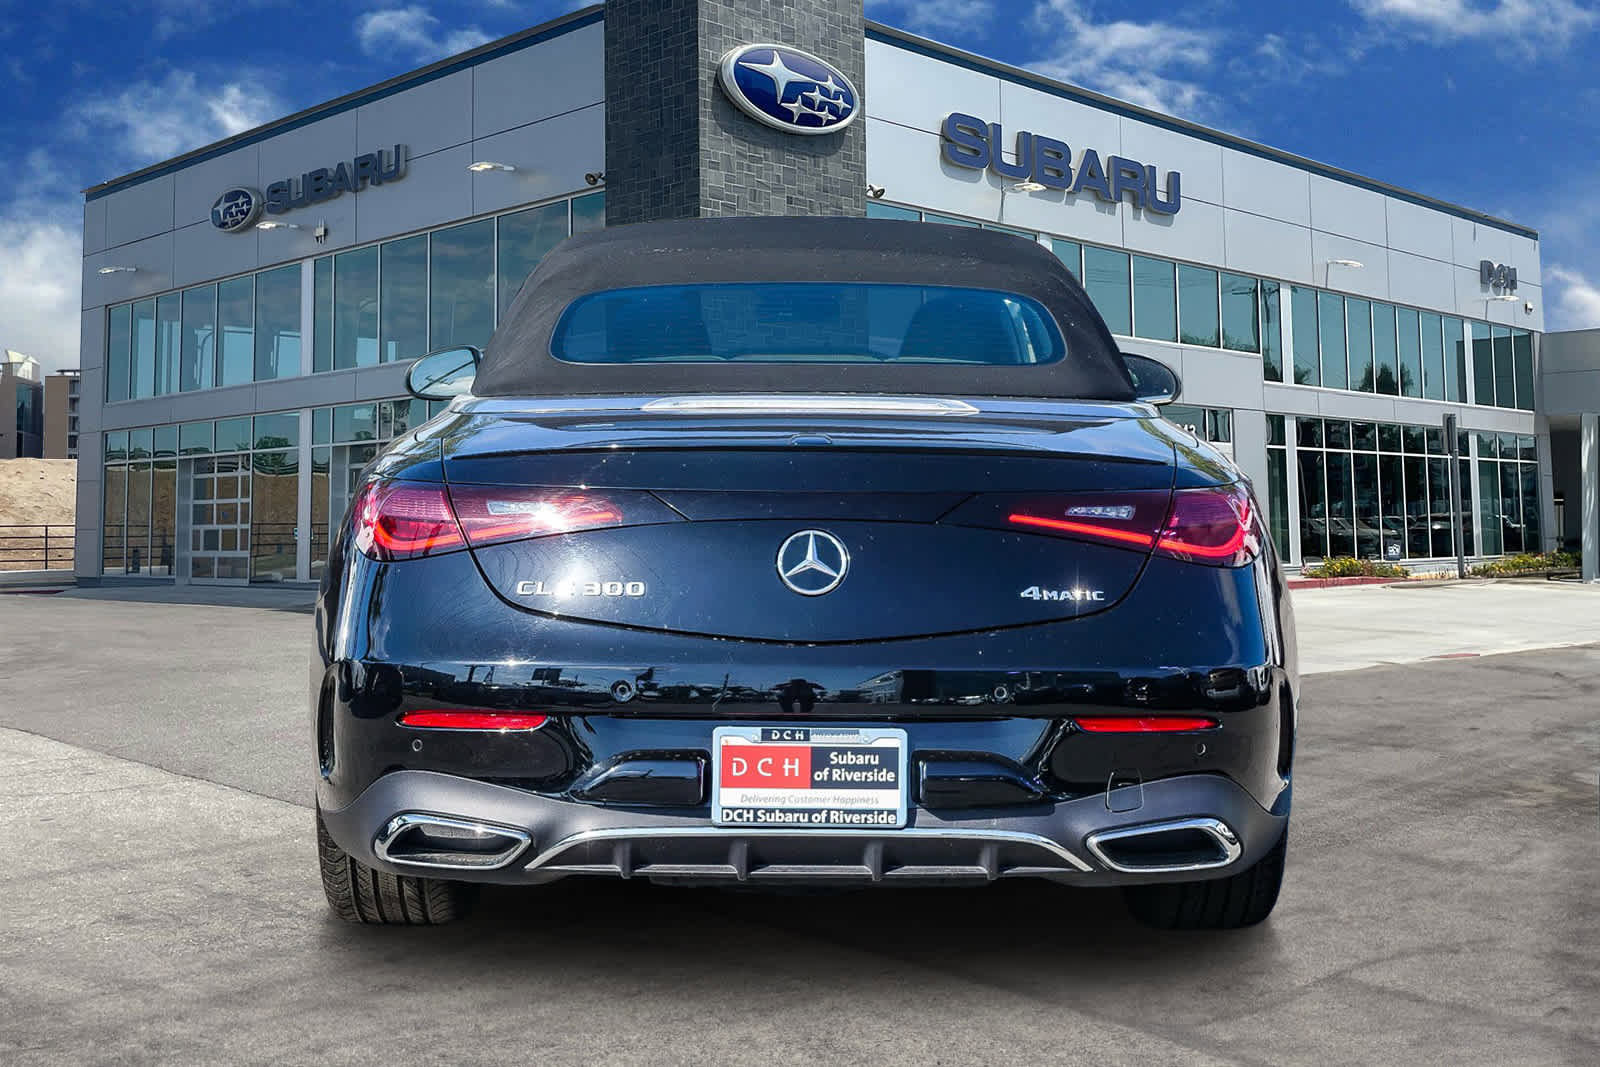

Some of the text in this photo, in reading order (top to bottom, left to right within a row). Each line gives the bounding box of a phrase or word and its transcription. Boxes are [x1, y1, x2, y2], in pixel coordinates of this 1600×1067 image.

[941, 112, 1181, 215] SUBARU
[265, 143, 408, 214] SUBARU
[516, 580, 646, 596] CL 300
[1020, 586, 1105, 601] 4MATIC
[829, 751, 880, 766] Subaru
[813, 767, 896, 783] of Riverside
[740, 793, 880, 807] Delivering Customer Happiness
[722, 809, 897, 824] DCH Subaru of Riverside
